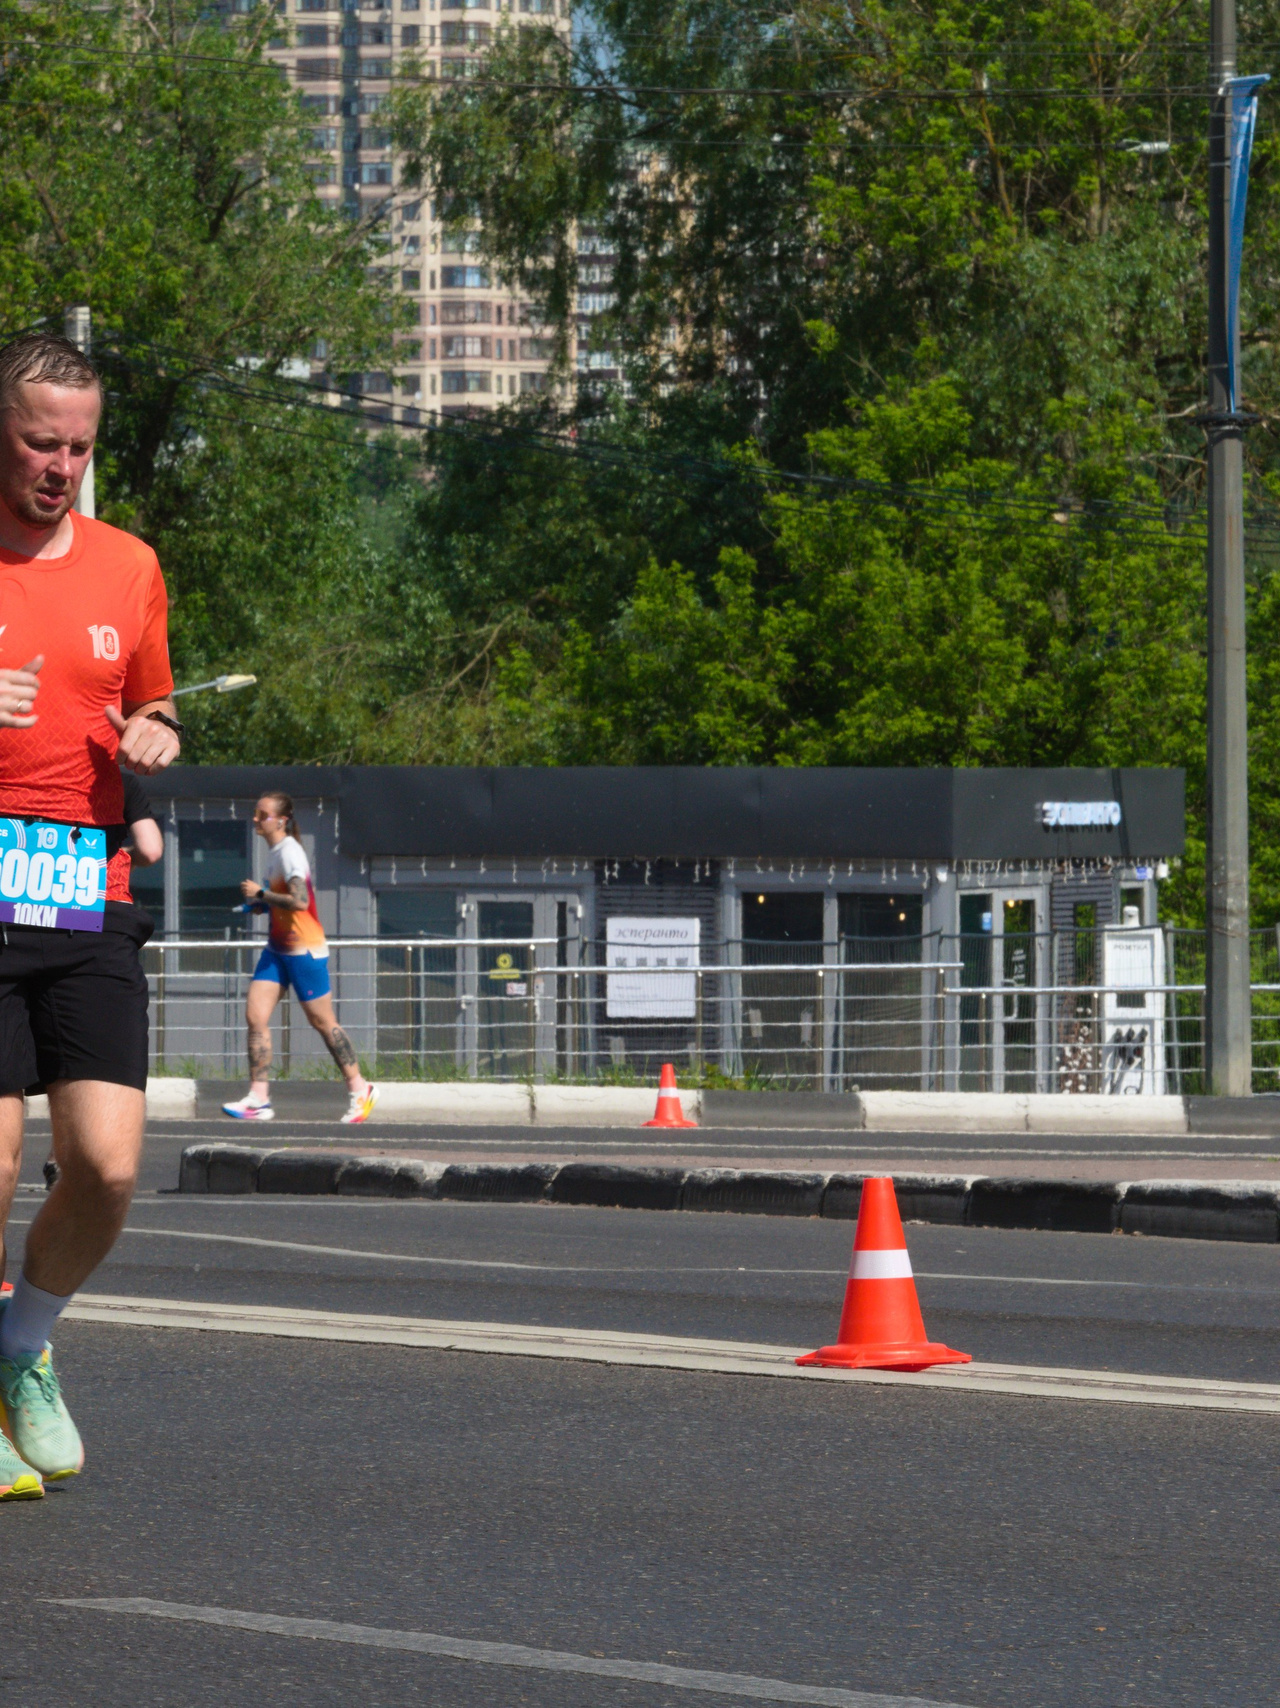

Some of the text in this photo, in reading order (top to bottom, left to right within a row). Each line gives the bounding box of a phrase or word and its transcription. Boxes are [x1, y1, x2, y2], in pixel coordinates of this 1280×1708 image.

[87, 624, 120, 661] 10
[36, 827, 58, 849] 10
[13, 902, 59, 928] 10KM
